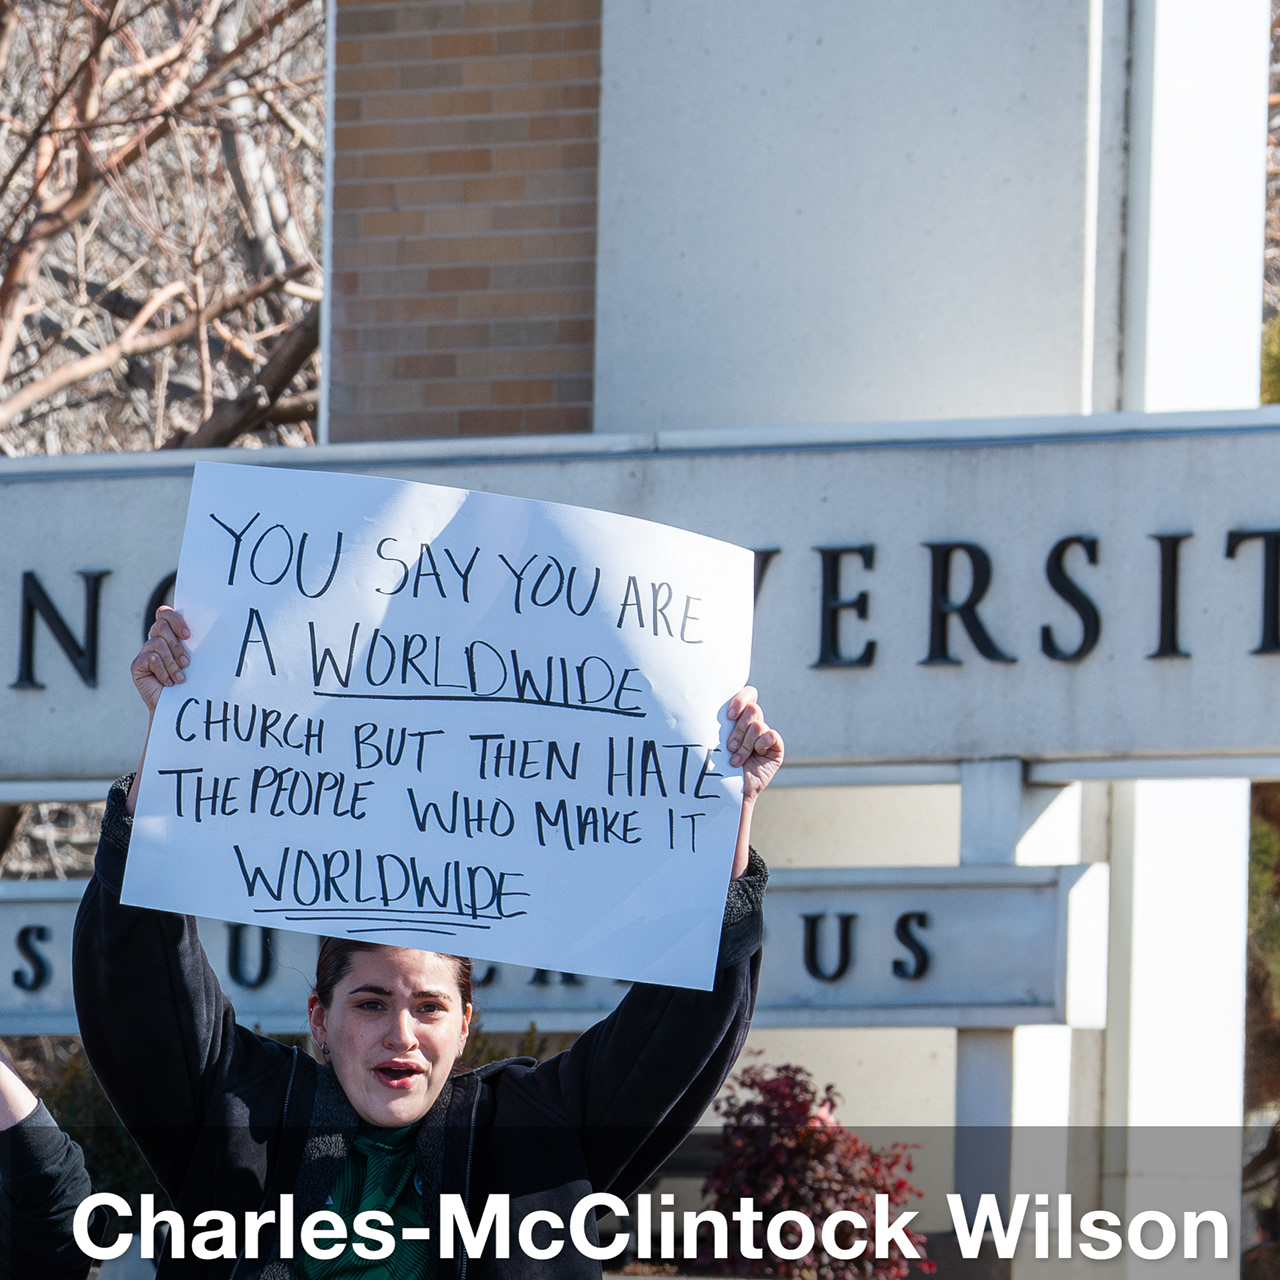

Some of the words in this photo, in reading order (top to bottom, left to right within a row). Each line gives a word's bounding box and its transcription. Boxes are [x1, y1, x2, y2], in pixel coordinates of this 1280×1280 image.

[209, 512, 343, 599] YOU
[375, 537, 480, 603] SAY
[498, 553, 601, 615] YOU
[617, 575, 704, 645] ARE
[235, 609, 277, 679] A
[309, 620, 642, 713] WORLDWIDE
[176, 697, 324, 755] CHURCH
[354, 722, 444, 771] BUT
[470, 733, 581, 780] THEN
[608, 736, 723, 801] HATE
[159, 767, 239, 823] THE
[250, 765, 375, 820] PEOPLE
[407, 788, 514, 838] WHO
[535, 798, 642, 851] MAKE
[668, 812, 706, 853] IT
[233, 844, 530, 919] WORLDWIDE
